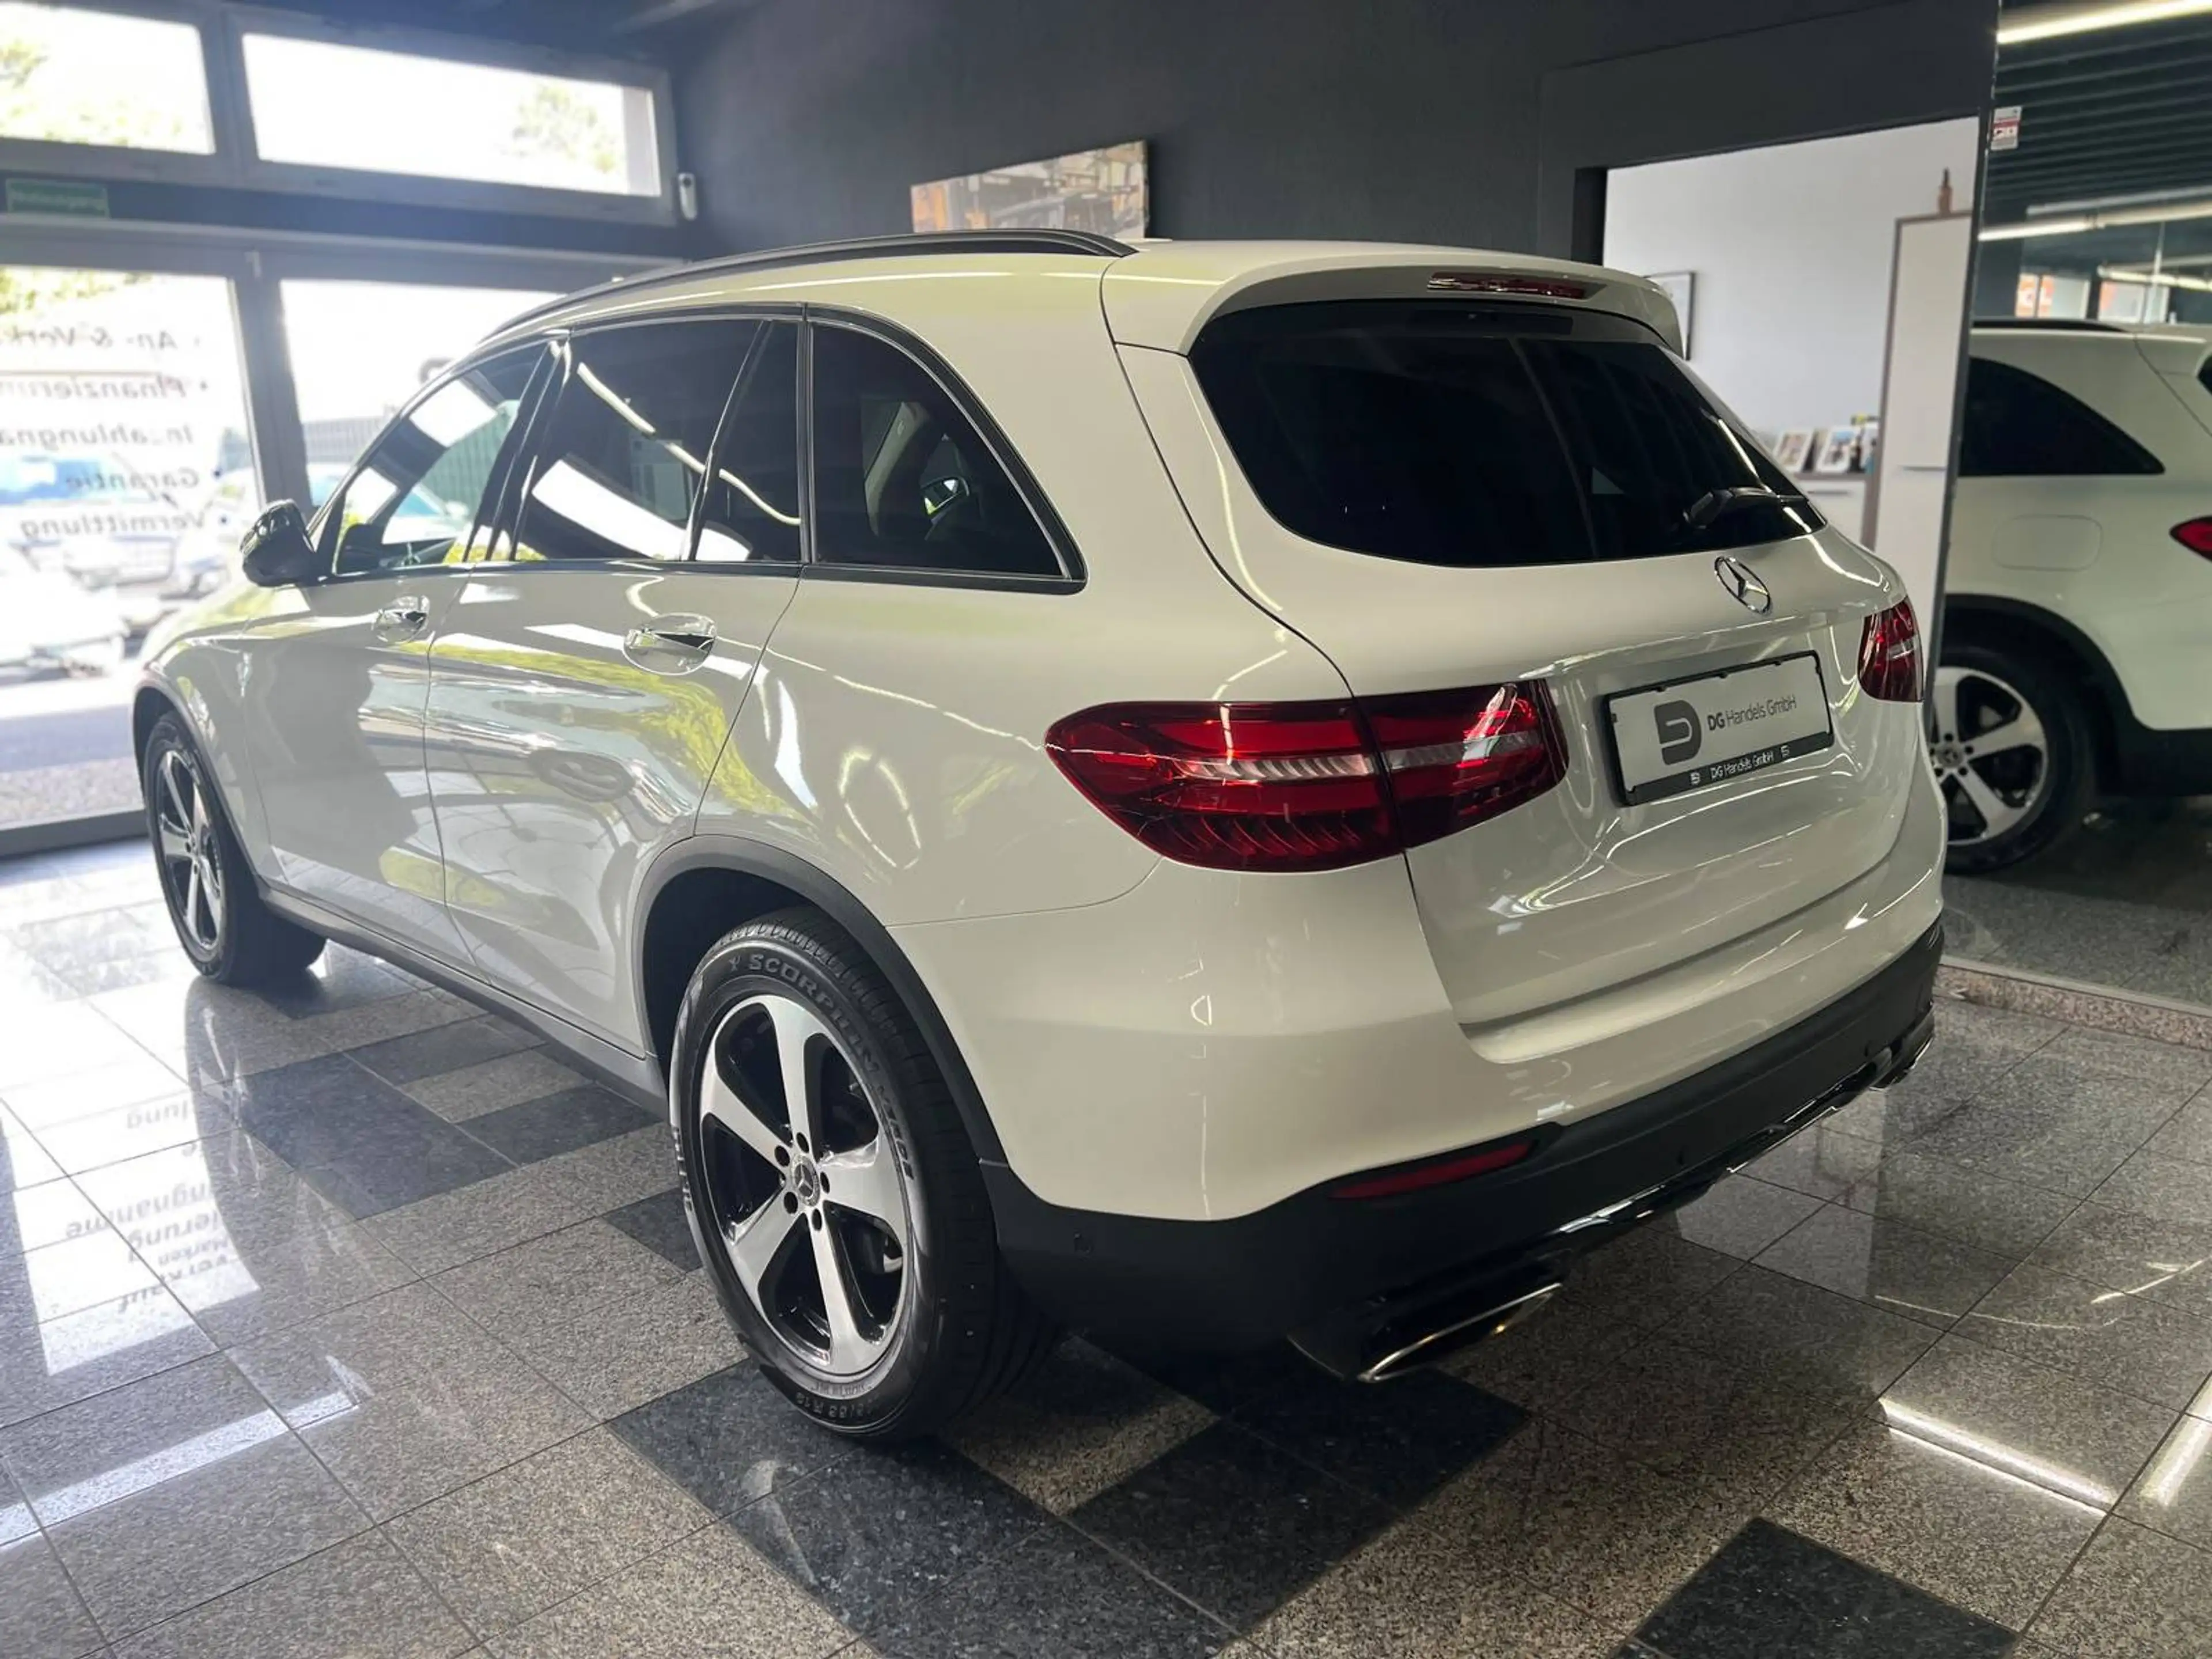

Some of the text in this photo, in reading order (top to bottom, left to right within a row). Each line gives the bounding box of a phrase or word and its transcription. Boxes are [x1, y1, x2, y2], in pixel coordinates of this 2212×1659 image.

[1707, 694, 1797, 731] DG Handels GmbH
[1710, 766, 1723, 781] DG
